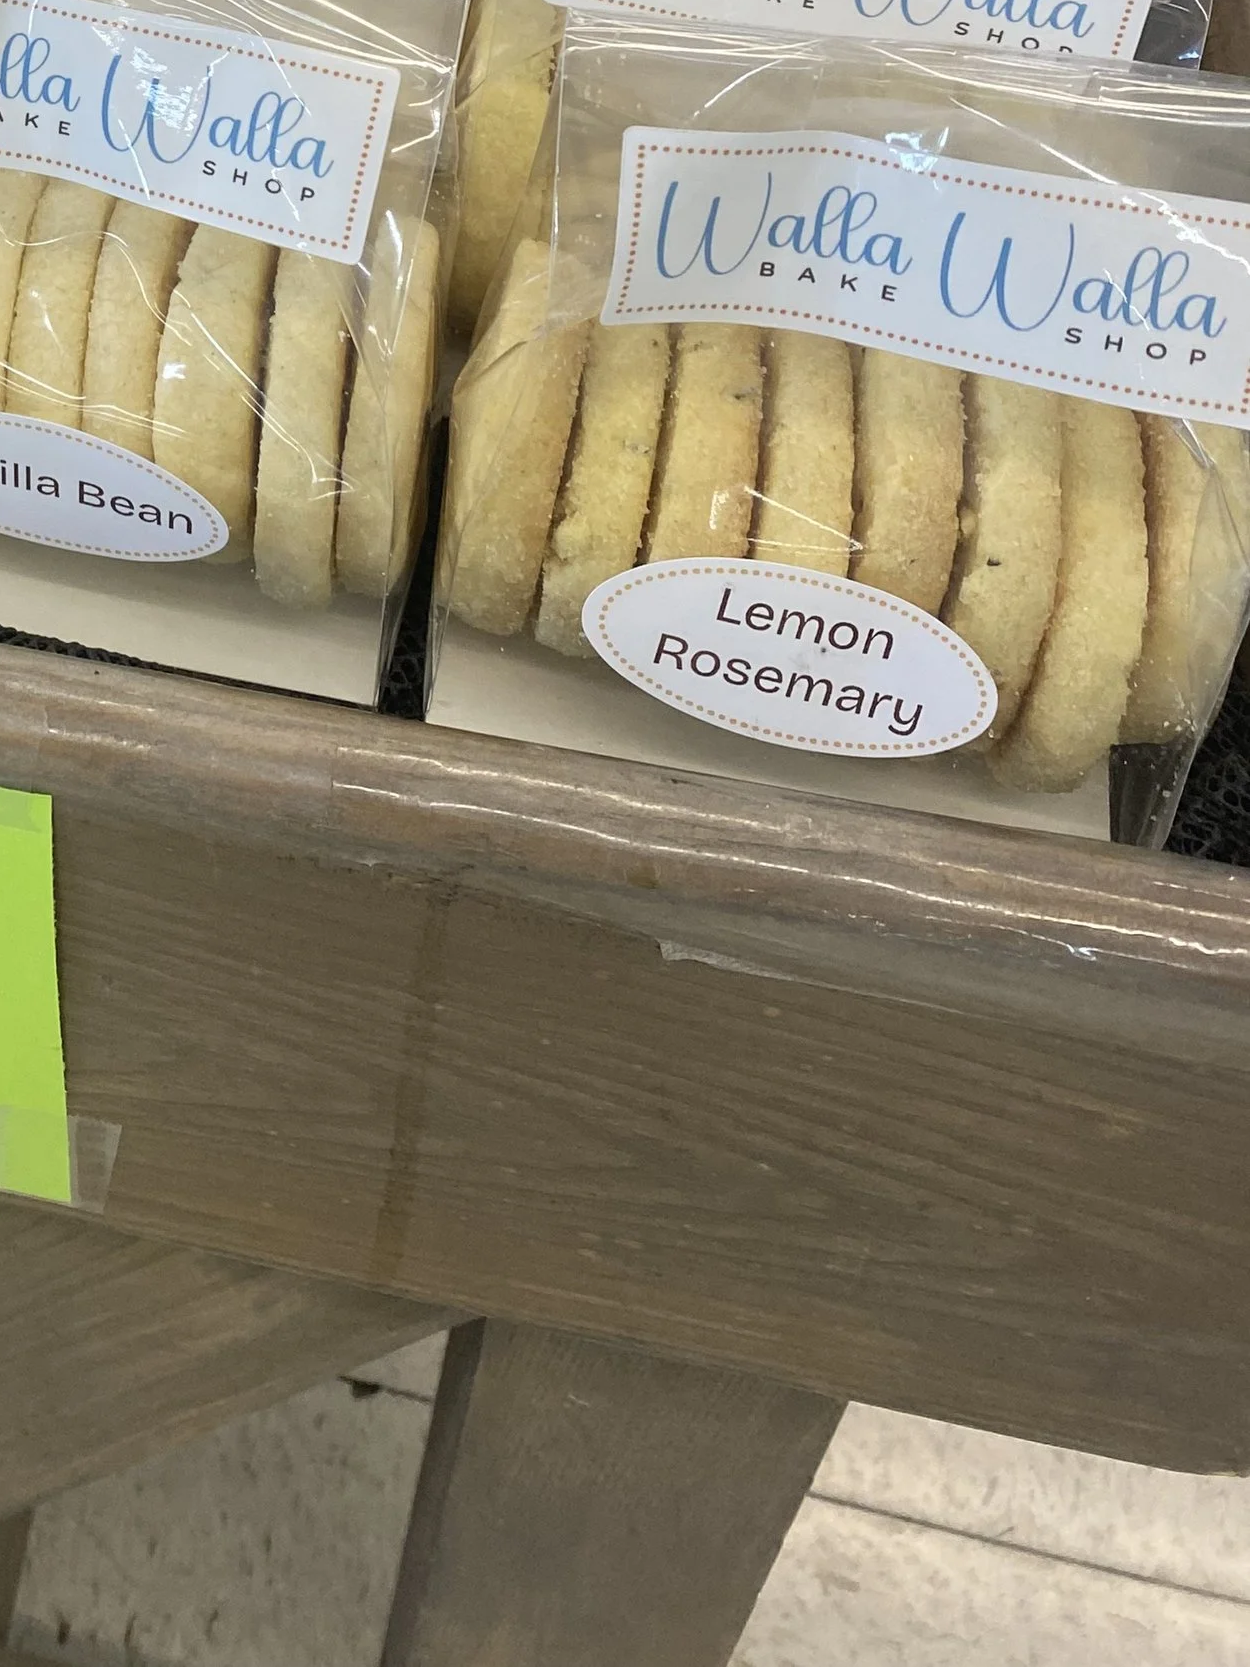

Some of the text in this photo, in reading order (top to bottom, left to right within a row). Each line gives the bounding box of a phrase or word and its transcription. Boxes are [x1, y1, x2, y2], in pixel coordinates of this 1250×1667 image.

[100, 53, 334, 179] Walla
[202, 159, 315, 203] SHOP
[655, 172, 1228, 339] Walla Walla
[758, 260, 1208, 367] BAKE SHOP
[77, 480, 194, 535] Bean
[714, 586, 895, 661] Lemon
[653, 634, 925, 737] Rosemary
